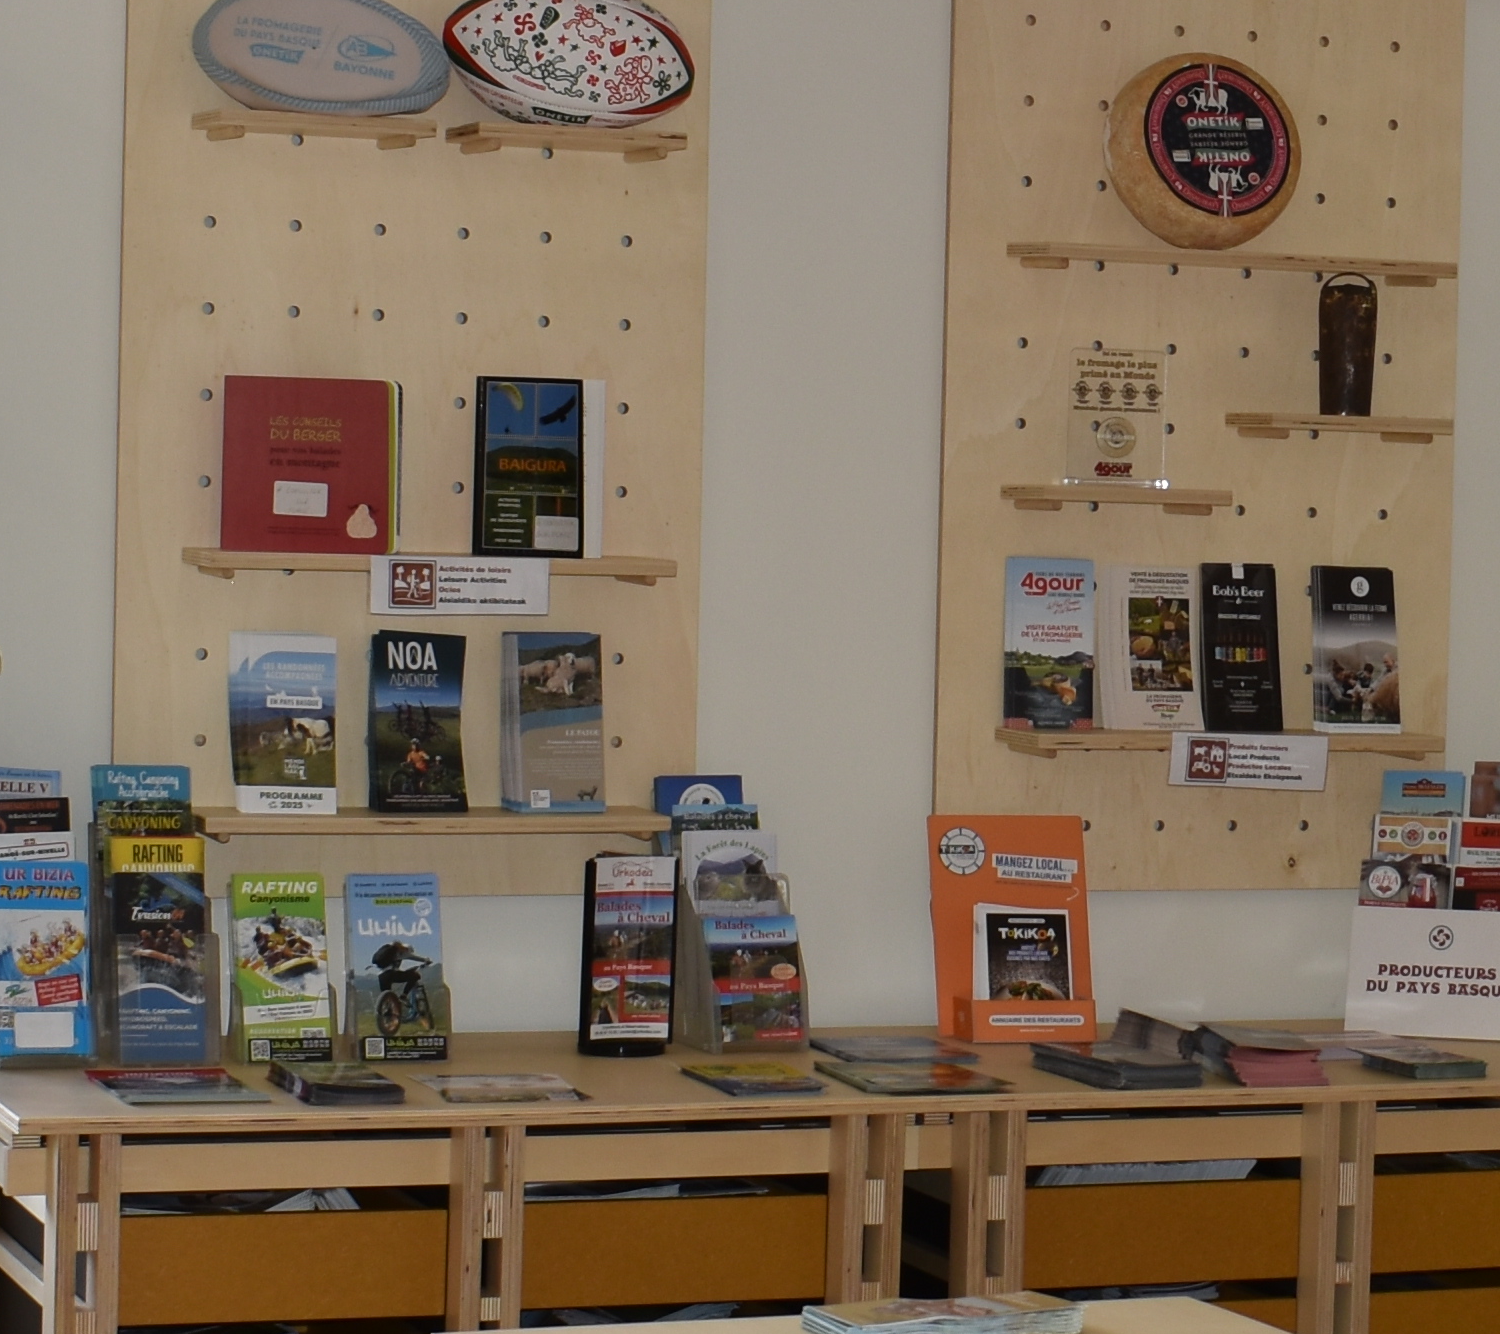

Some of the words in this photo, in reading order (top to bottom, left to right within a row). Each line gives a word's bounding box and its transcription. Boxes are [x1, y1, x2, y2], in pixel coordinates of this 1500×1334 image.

[236, 15, 249, 25] LA
[251, 17, 323, 36] FROMAGERIE
[234, 28, 248, 37] DU
[251, 29, 276, 43] PAYS
[333, 60, 396, 80] BAYONNE
[270, 416, 290, 426] LES
[293, 417, 342, 428] CONSEILS
[270, 428, 290, 441] DU
[294, 429, 342, 442] BERGER
[499, 458, 566, 473] BAIGURA
[439, 565, 474, 574] Activités
[439, 576, 468, 584] Leisure
[470, 576, 507, 584] Activities
[439, 586, 461, 594] Ocios
[1212, 586, 1239, 596] Bob's
[1241, 586, 1264, 597] Beer
[1041, 631, 1083, 639] FROMAGERIE
[388, 641, 438, 671] NOA
[390, 673, 439, 688] ADVENTURE
[1260, 744, 1288, 752] fermiers
[40, 783, 48, 793] V
[260, 792, 323, 800] PROGRAMME
[108, 817, 181, 829] CANYONING
[133, 844, 183, 863] RAFTING
[995, 856, 1034, 870] MANGEZ
[4, 869, 26, 881] UR
[33, 869, 74, 881] BIZIA
[1015, 870, 1067, 881] RESTAURANT
[242, 881, 318, 894] RAFTING
[250, 894, 310, 905] Canyonisme
[597, 902, 641, 913] Balades
[617, 912, 624, 923] à
[627, 912, 670, 923] Cheval
[715, 921, 754, 930] Balades
[742, 930, 747, 939] à
[750, 929, 786, 939] Cheval
[612, 964, 626, 972] Pays
[628, 963, 652, 972] Basque
[1378, 964, 1496, 981] PRODUCTEURS
[738, 982, 753, 990] Pays
[755, 982, 784, 990] Basque
[1366, 980, 1389, 992] DU
[1395, 982, 1441, 994] PAYS
